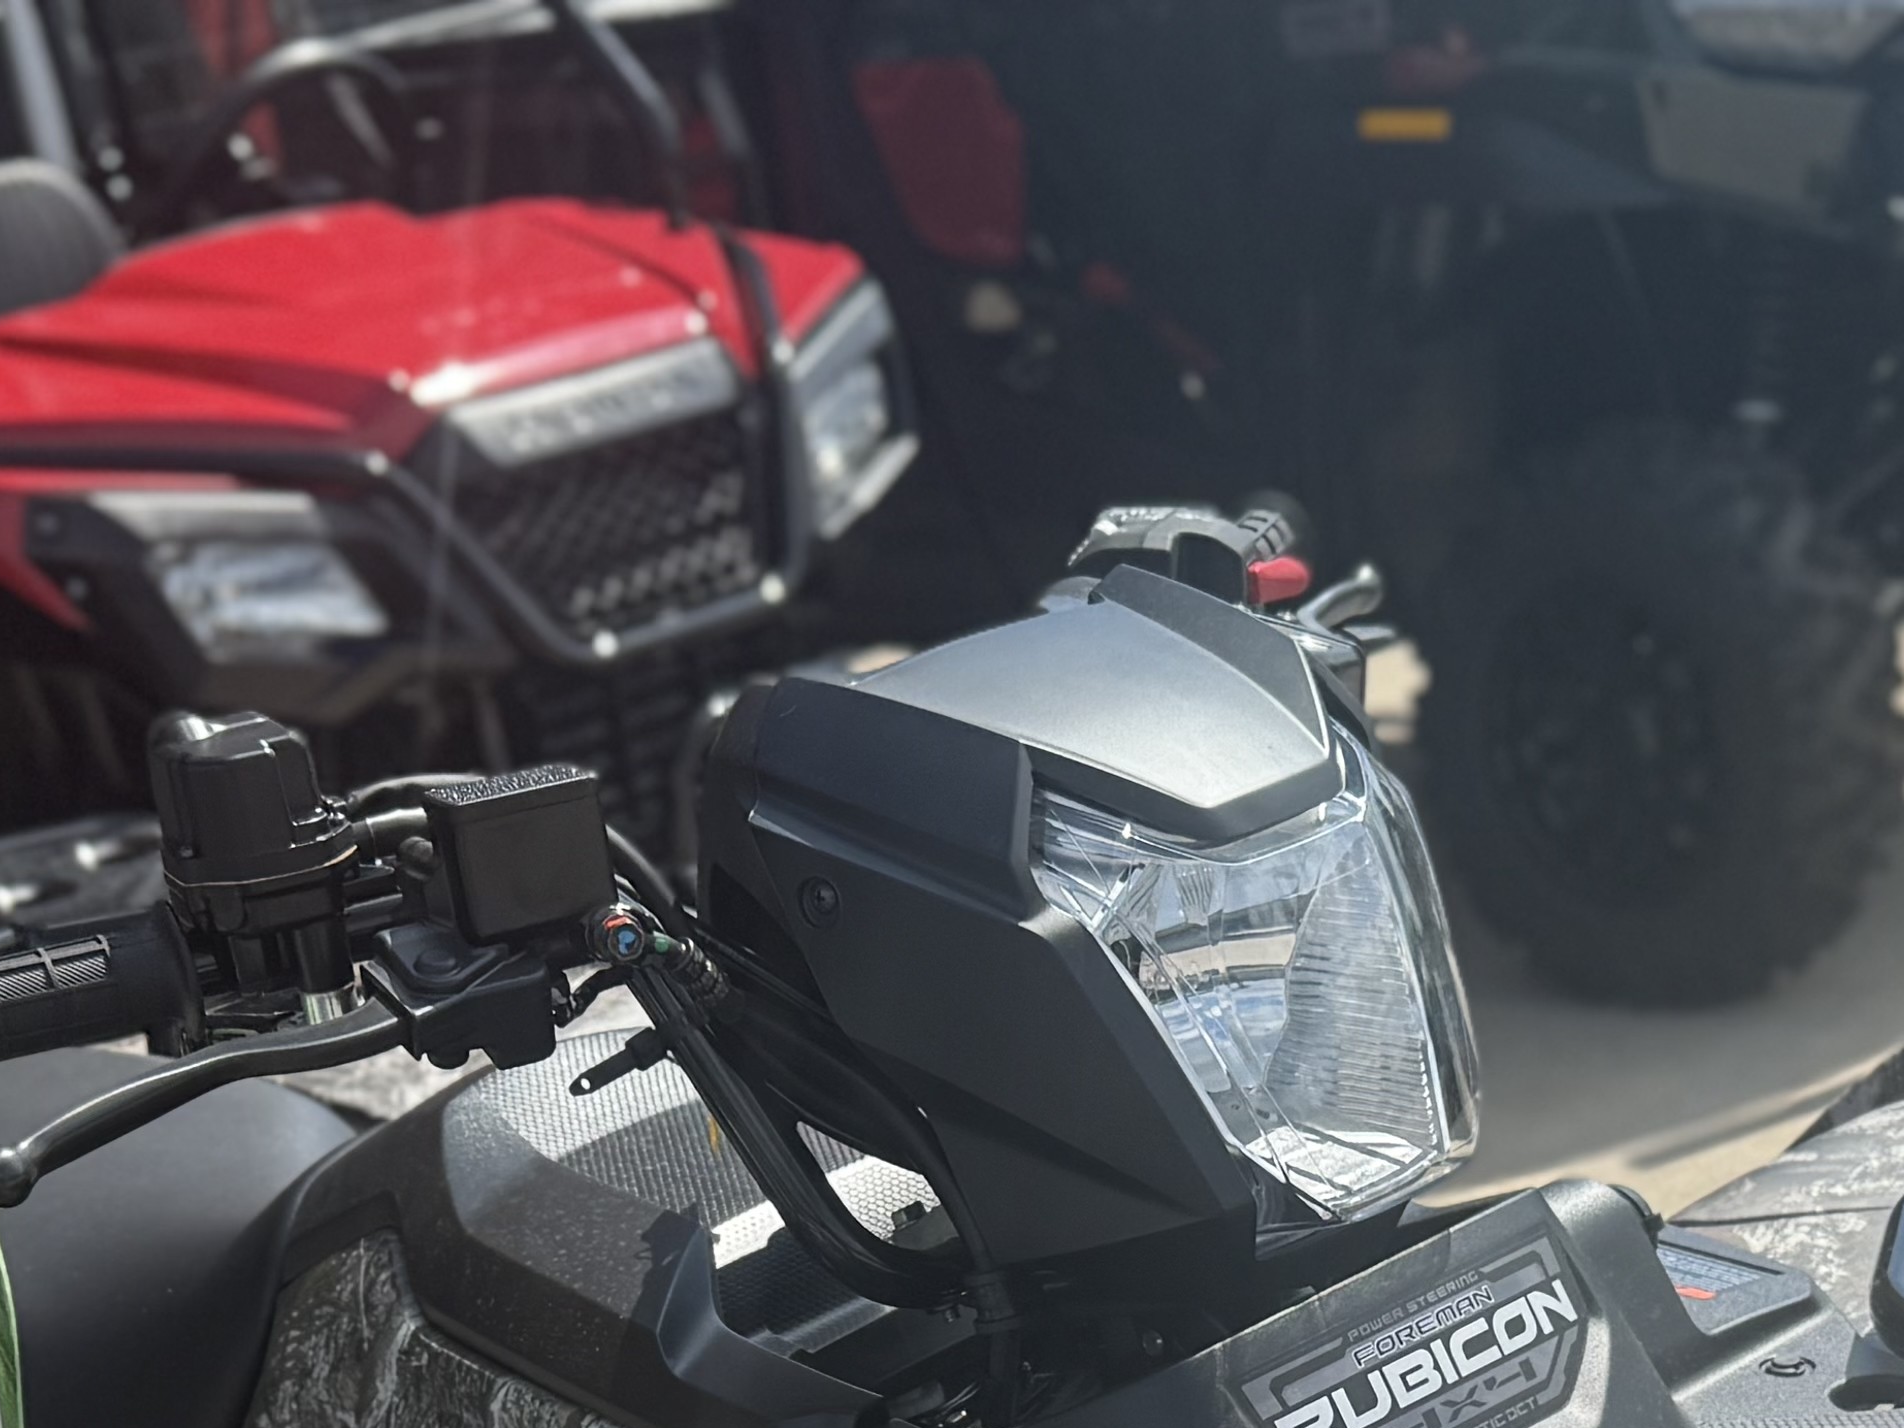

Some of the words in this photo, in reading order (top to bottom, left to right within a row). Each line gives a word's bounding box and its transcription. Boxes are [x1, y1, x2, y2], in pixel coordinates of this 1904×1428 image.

[1347, 1308, 1405, 1342] POWER
[1408, 1271, 1479, 1314] STEERING
[1352, 1284, 1496, 1369] FOREMAN
[1507, 1395, 1536, 1422] DCT
